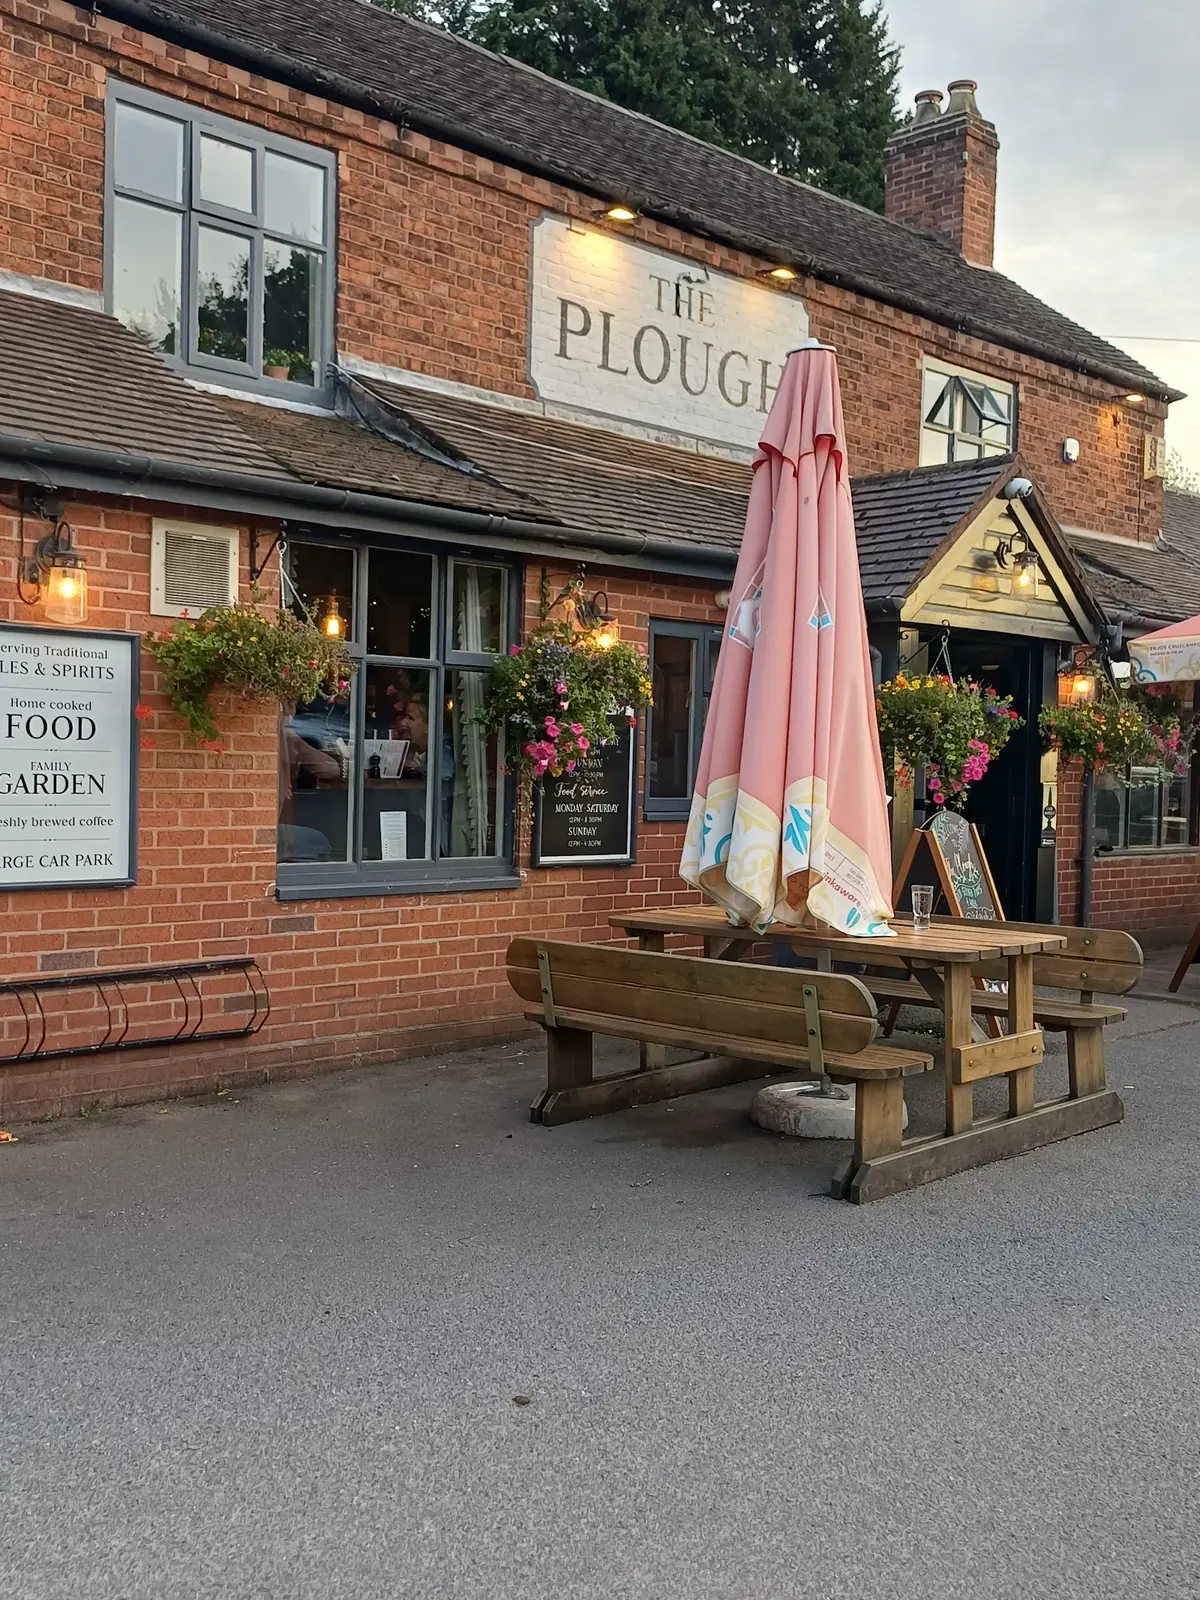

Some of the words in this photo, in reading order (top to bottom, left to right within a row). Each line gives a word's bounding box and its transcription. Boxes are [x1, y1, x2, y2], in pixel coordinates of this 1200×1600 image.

[649, 274, 715, 328] THE
[44, 645, 108, 660] Traditional
[34, 662, 46, 676] &
[52, 663, 115, 680] SPIRITS
[11, 697, 46, 709] Home
[49, 699, 92, 711] cooked
[5, 713, 97, 741] FOOD
[30, 761, 72, 772] FAMILY
[577, 758, 603, 768] UNDAY
[0, 773, 106, 795] GARDEN
[554, 782, 578, 799] Food
[580, 784, 609, 798] Service
[31, 816, 76, 827] brewed
[79, 816, 114, 827] coffee
[568, 826, 598, 836] SUNDAY
[0, 855, 34, 869] RGE
[39, 854, 70, 868] CAR
[75, 853, 113, 867] PARK
